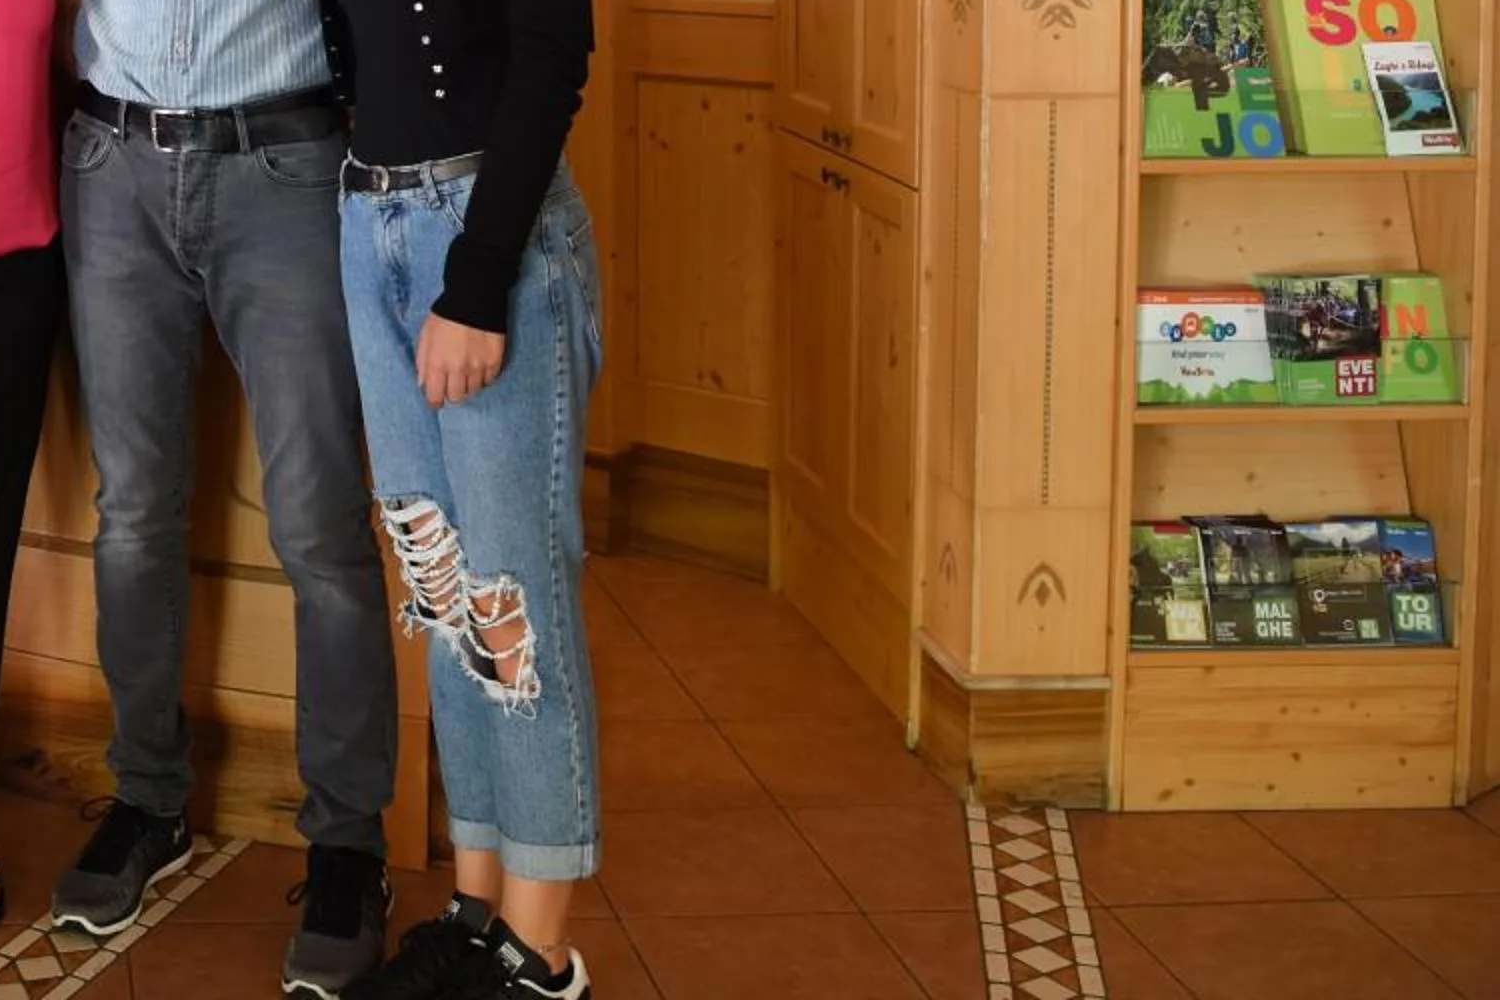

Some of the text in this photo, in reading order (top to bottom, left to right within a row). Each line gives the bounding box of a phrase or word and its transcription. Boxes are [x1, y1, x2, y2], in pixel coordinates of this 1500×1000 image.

[1200, 110, 1285, 158] JO
[1338, 359, 1375, 375] EVE
[1338, 376, 1376, 394] NTI
[1255, 602, 1291, 618] MAL
[1395, 595, 1429, 612] TO
[1257, 620, 1293, 638] GHE
[1399, 613, 1433, 631] UR
